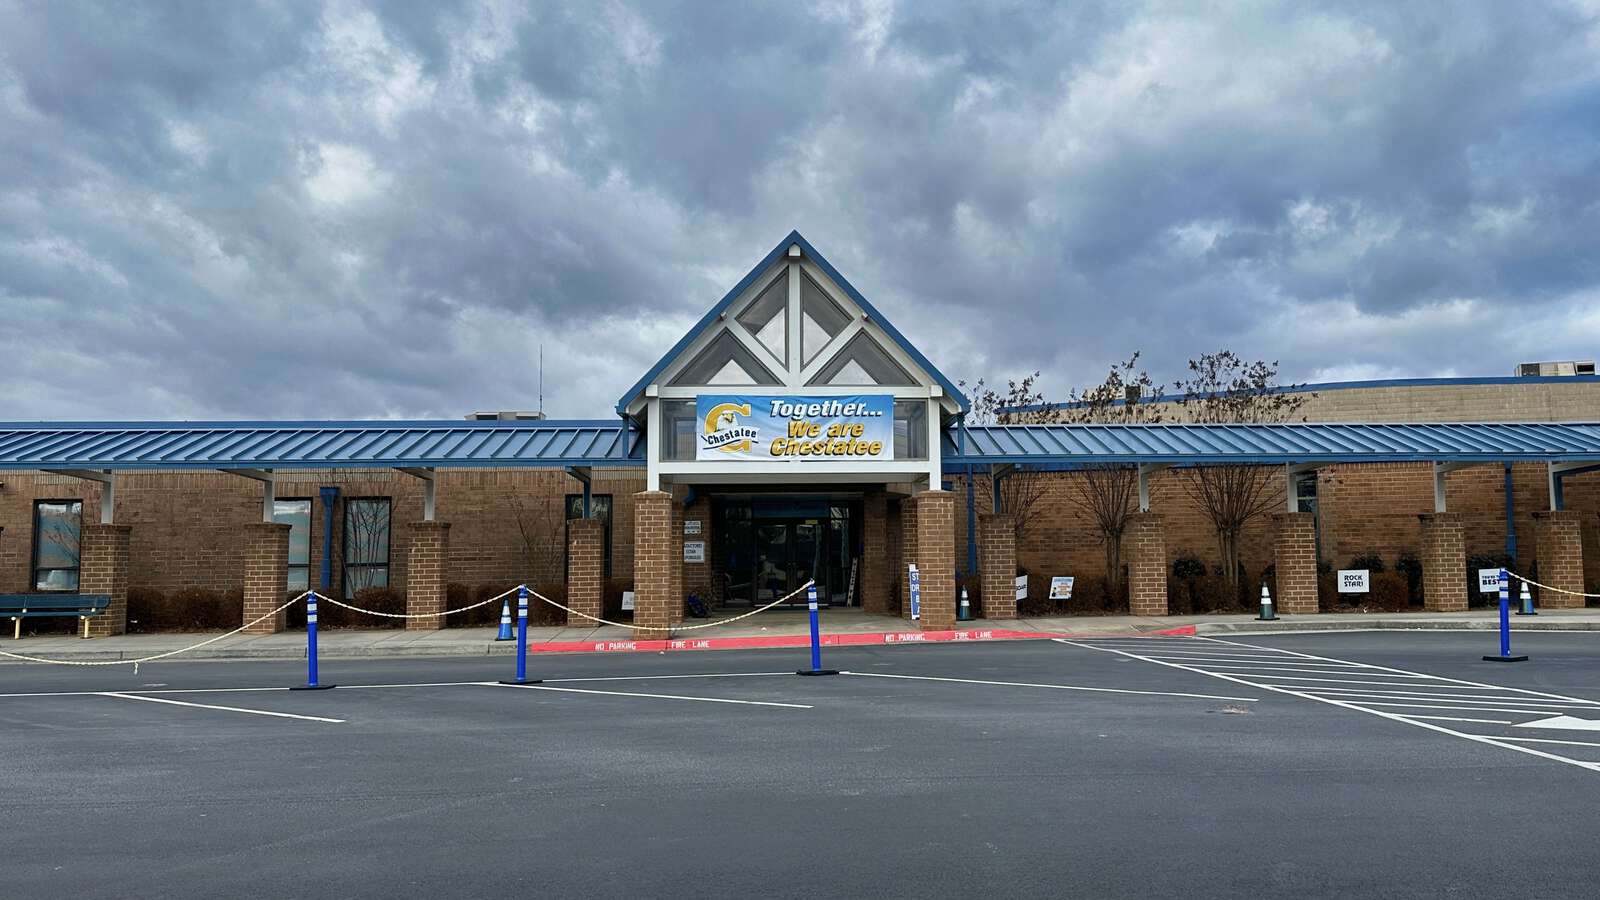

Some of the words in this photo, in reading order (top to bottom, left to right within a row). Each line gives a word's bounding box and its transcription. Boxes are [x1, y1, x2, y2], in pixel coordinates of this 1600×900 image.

[769, 399, 883, 421] Together...
[707, 427, 757, 445] Chestatee
[787, 420, 822, 439] We
[826, 421, 866, 438] are
[769, 436, 883, 457] Chestatee
[885, 634, 895, 642] NO
[898, 633, 925, 641] PARKING
[954, 631, 969, 640] FIRE
[974, 631, 993, 639] LANE
[608, 642, 637, 650] PARKING
[671, 640, 686, 649] FIRE
[692, 640, 710, 648] LANE
